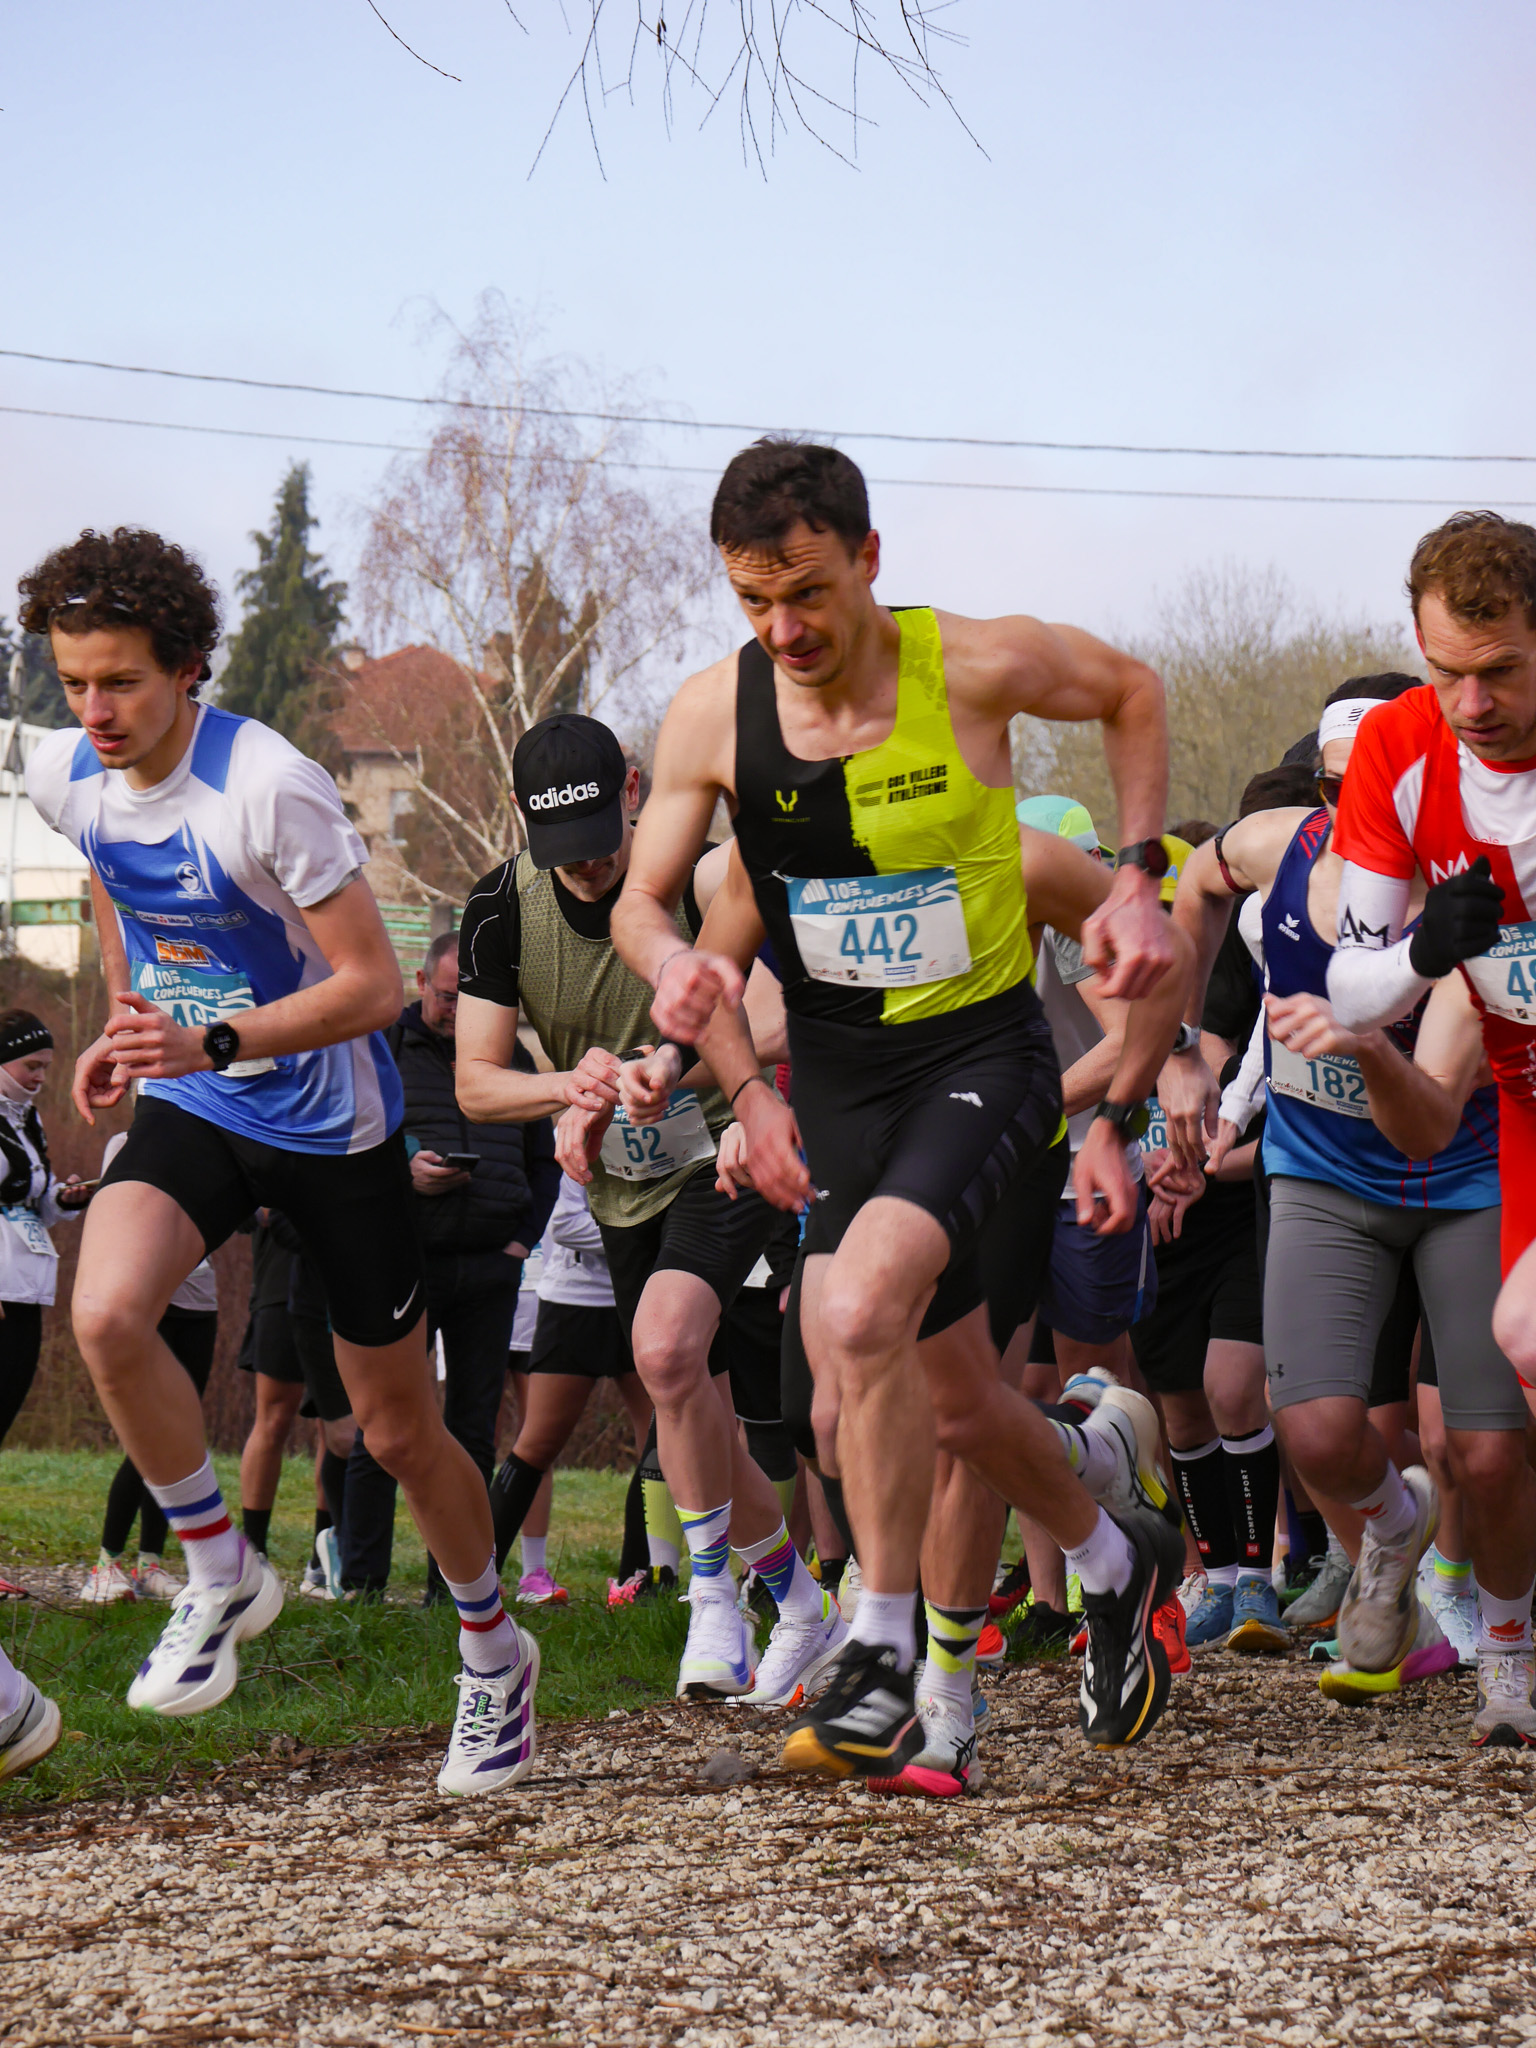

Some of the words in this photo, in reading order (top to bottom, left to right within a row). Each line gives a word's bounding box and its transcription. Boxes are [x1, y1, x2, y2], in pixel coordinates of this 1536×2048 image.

[909, 764, 948, 780] VILLERS
[529, 781, 600, 811] adidas
[825, 884, 924, 915] CONFLUENCES
[828, 882, 850, 901] 10
[840, 913, 922, 964] 442
[1277, 922, 1301, 942] erima
[153, 986, 223, 1000] CONFLUENCES
[156, 970, 173, 988] 10
[1305, 1060, 1369, 1105] 182
[621, 1126, 667, 1163] 52
[1181, 1471, 1202, 1538] COMPRESSPORT
[1240, 1469, 1256, 1540] COMPRESSPORT
